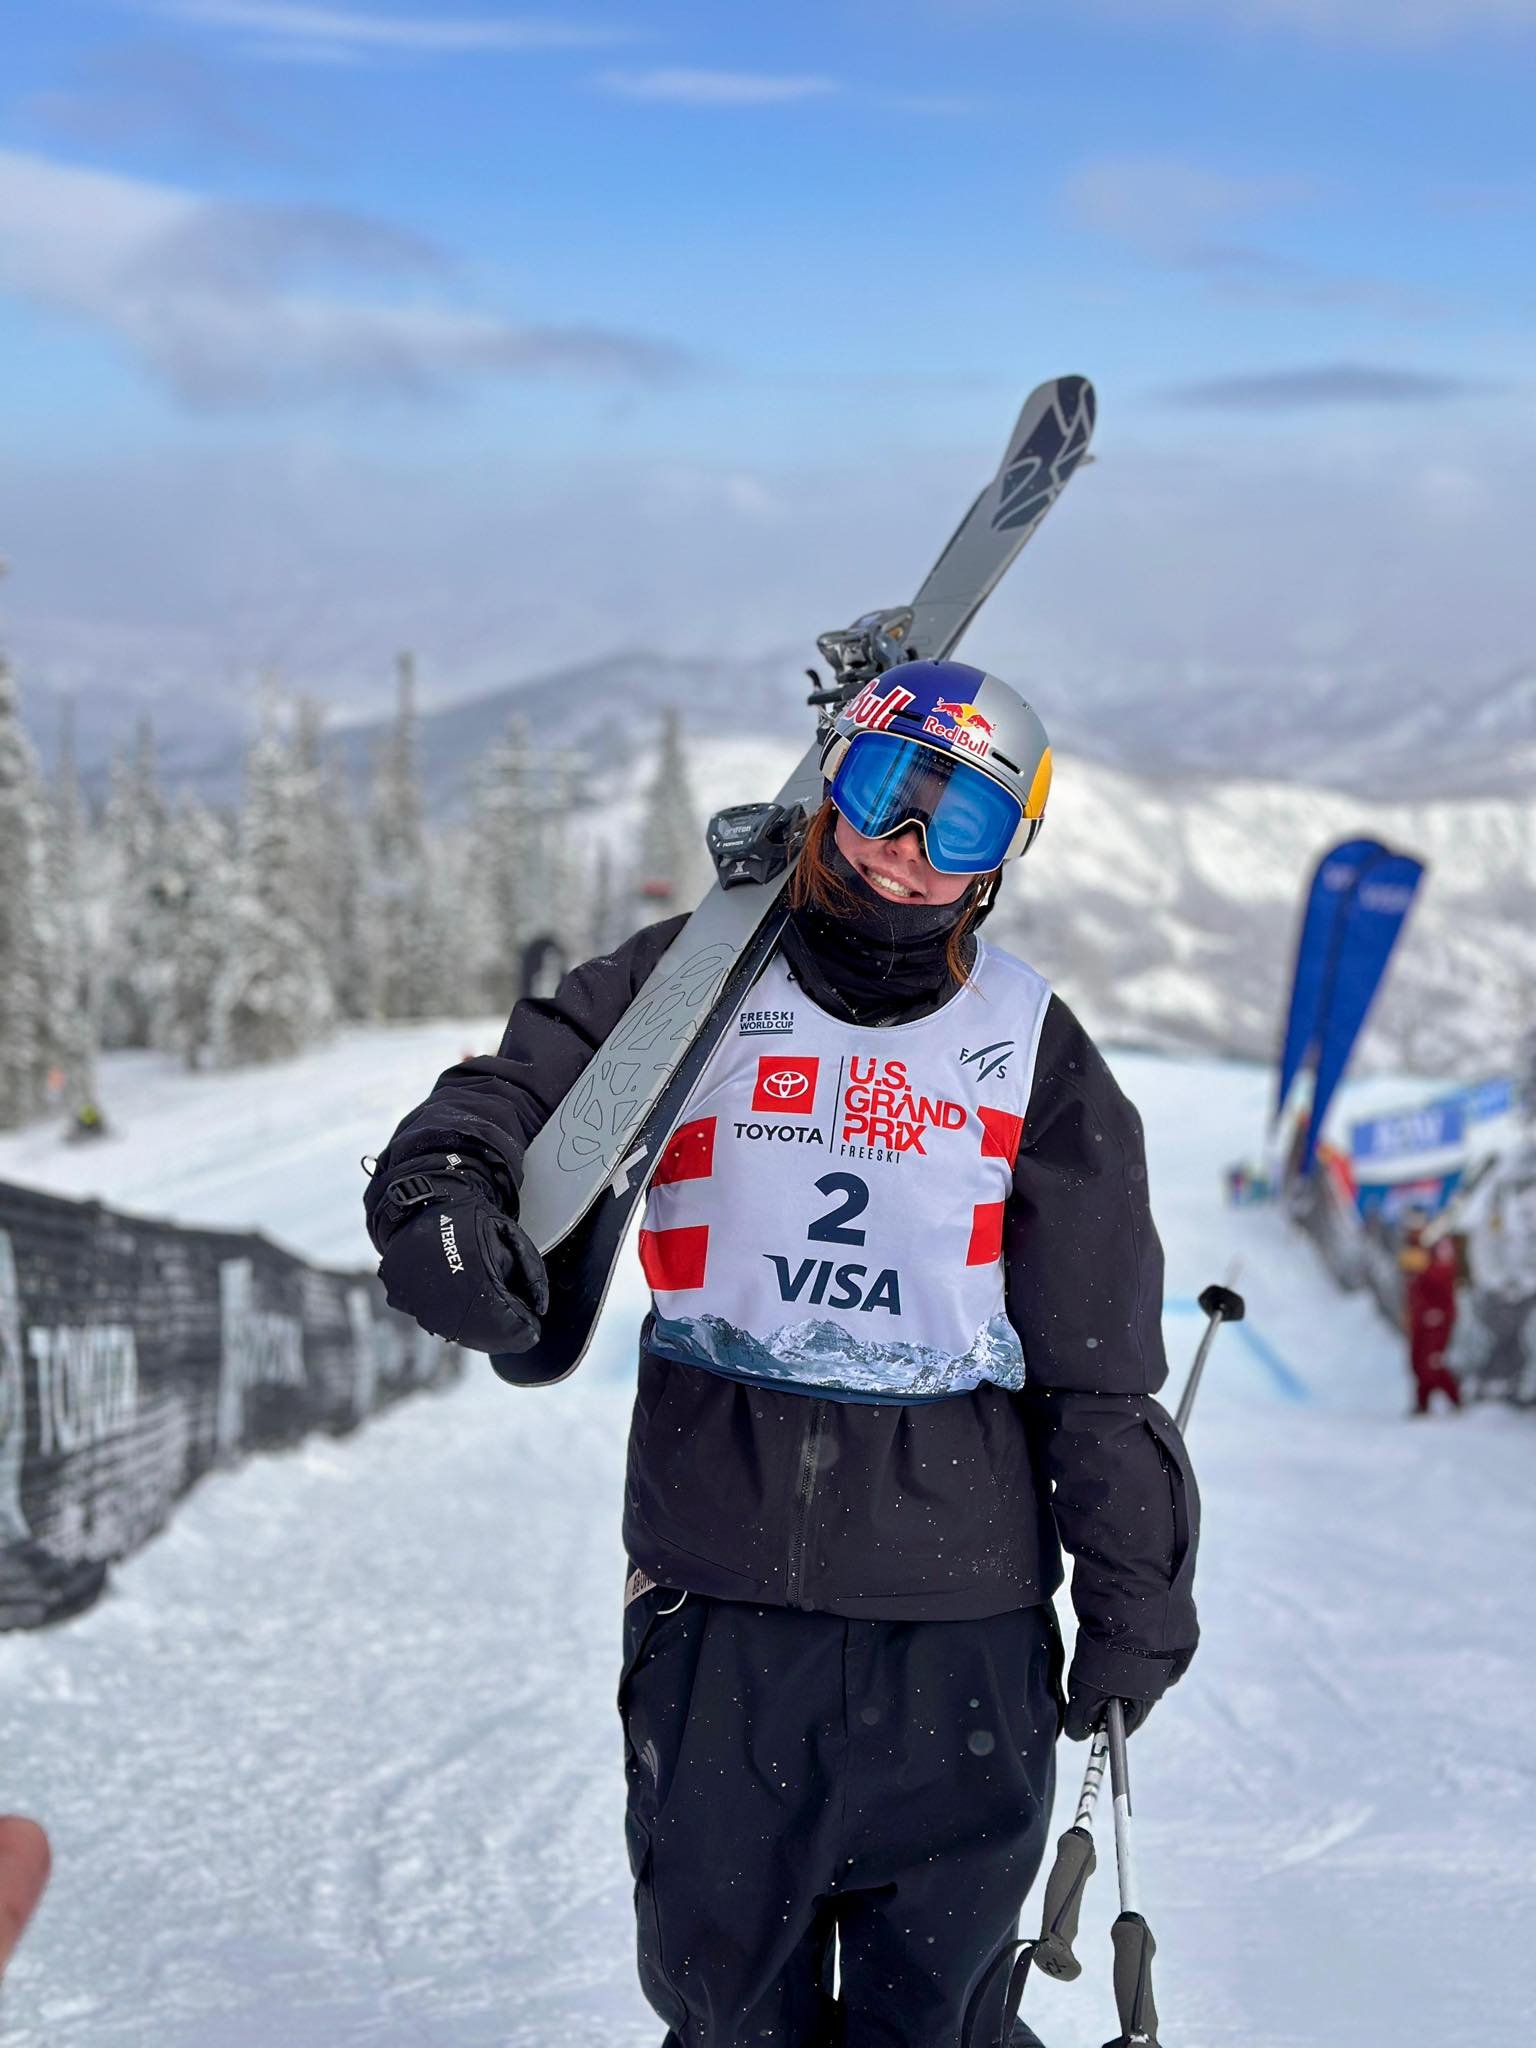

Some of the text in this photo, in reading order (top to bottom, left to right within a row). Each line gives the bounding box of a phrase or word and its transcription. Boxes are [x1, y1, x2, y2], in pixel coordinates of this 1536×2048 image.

[844, 680, 913, 731] Bull
[924, 717, 989, 757] Red Bull
[740, 1011, 794, 1022] FREESKI
[740, 1020, 794, 1030] WORLD CUP
[850, 1056, 912, 1092] U.S.
[844, 1085, 967, 1130] GRAND
[734, 1123, 824, 1145] TOYOTA
[840, 1145, 900, 1164] FREESKI
[843, 1113, 928, 1156] PRIX
[807, 1171, 870, 1247] 2
[440, 1224, 465, 1274] TERREX
[762, 1254, 902, 1316] VISA
